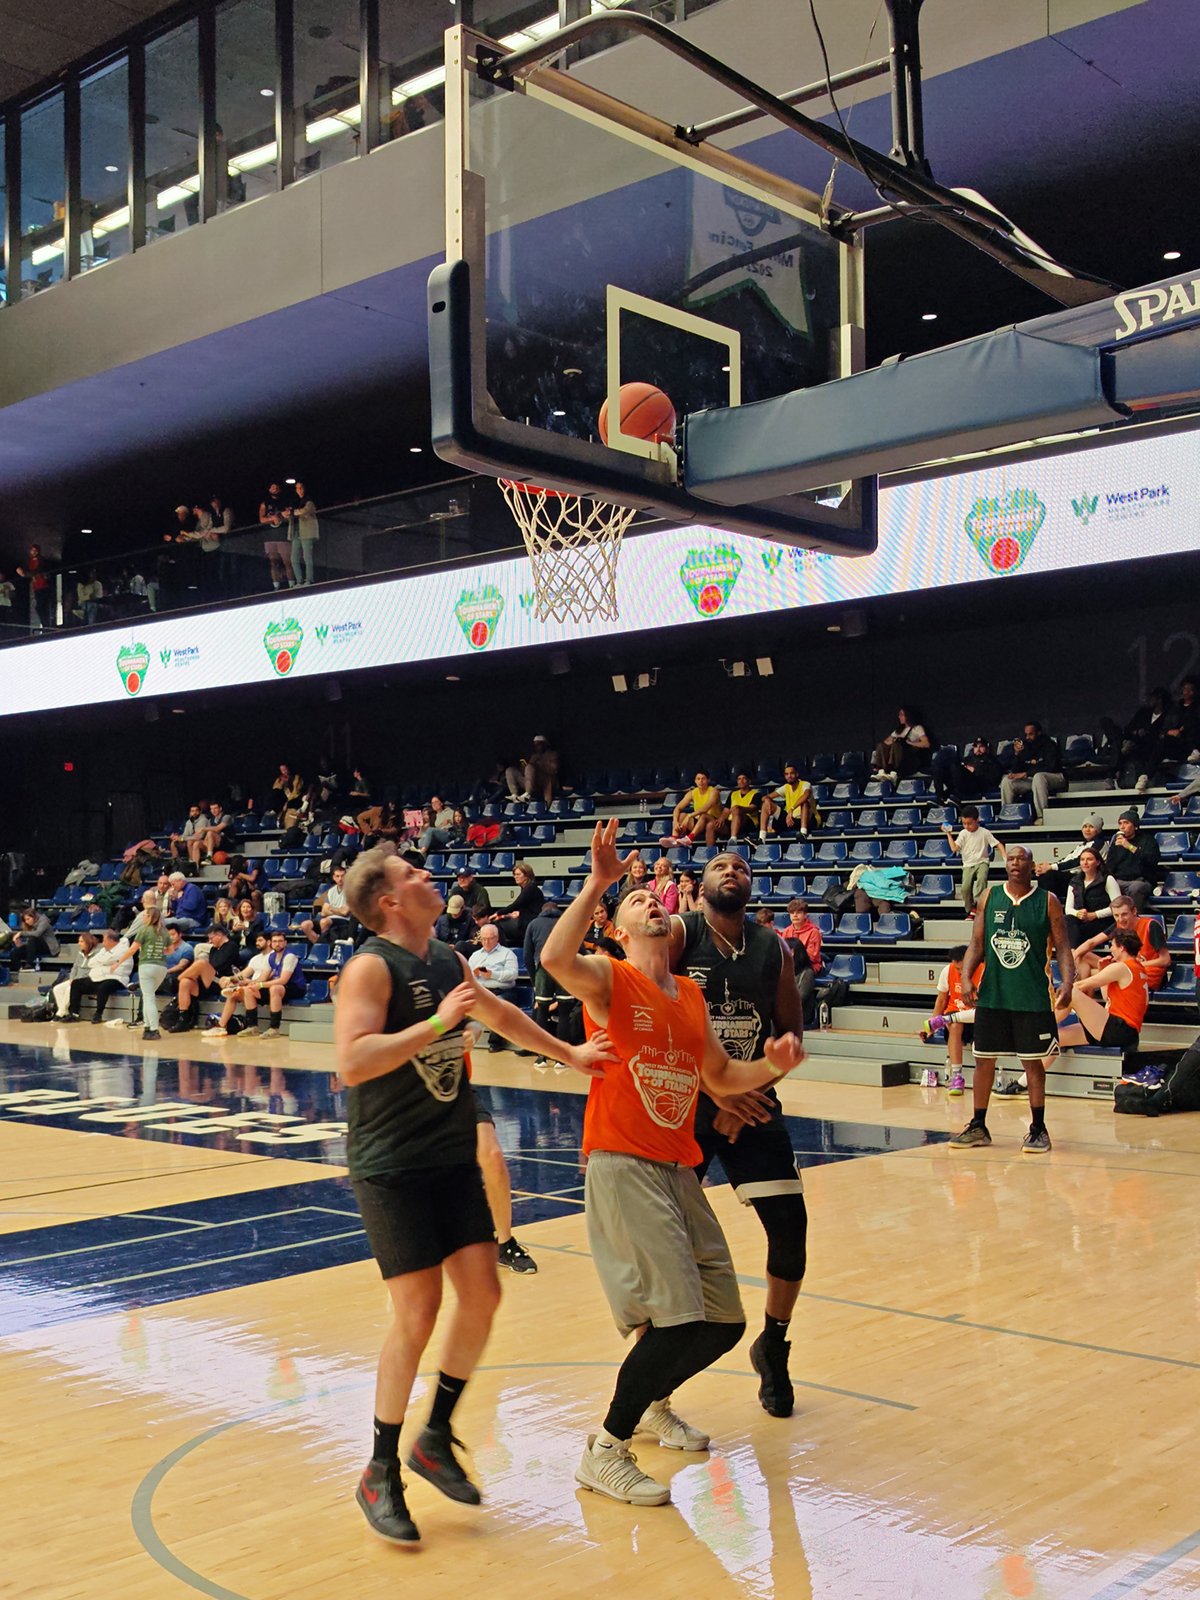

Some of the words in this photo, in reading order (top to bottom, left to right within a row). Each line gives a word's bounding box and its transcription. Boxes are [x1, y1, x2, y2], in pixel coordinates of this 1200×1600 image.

[1106, 491, 1138, 505] West
[1140, 484, 1170, 499] Park
[332, 623, 347, 632] West
[348, 621, 362, 630] Park
[1053, 847, 1059, 858] E
[552, 860, 556, 869] E
[510, 890, 515, 899] D
[928, 970, 935, 981] B
[882, 1016, 889, 1028] A
[723, 1029, 749, 1038] STARS
[637, 1062, 697, 1089] TOURNAMENT
[650, 1078, 663, 1088] OF
[664, 1080, 689, 1093] STARS
